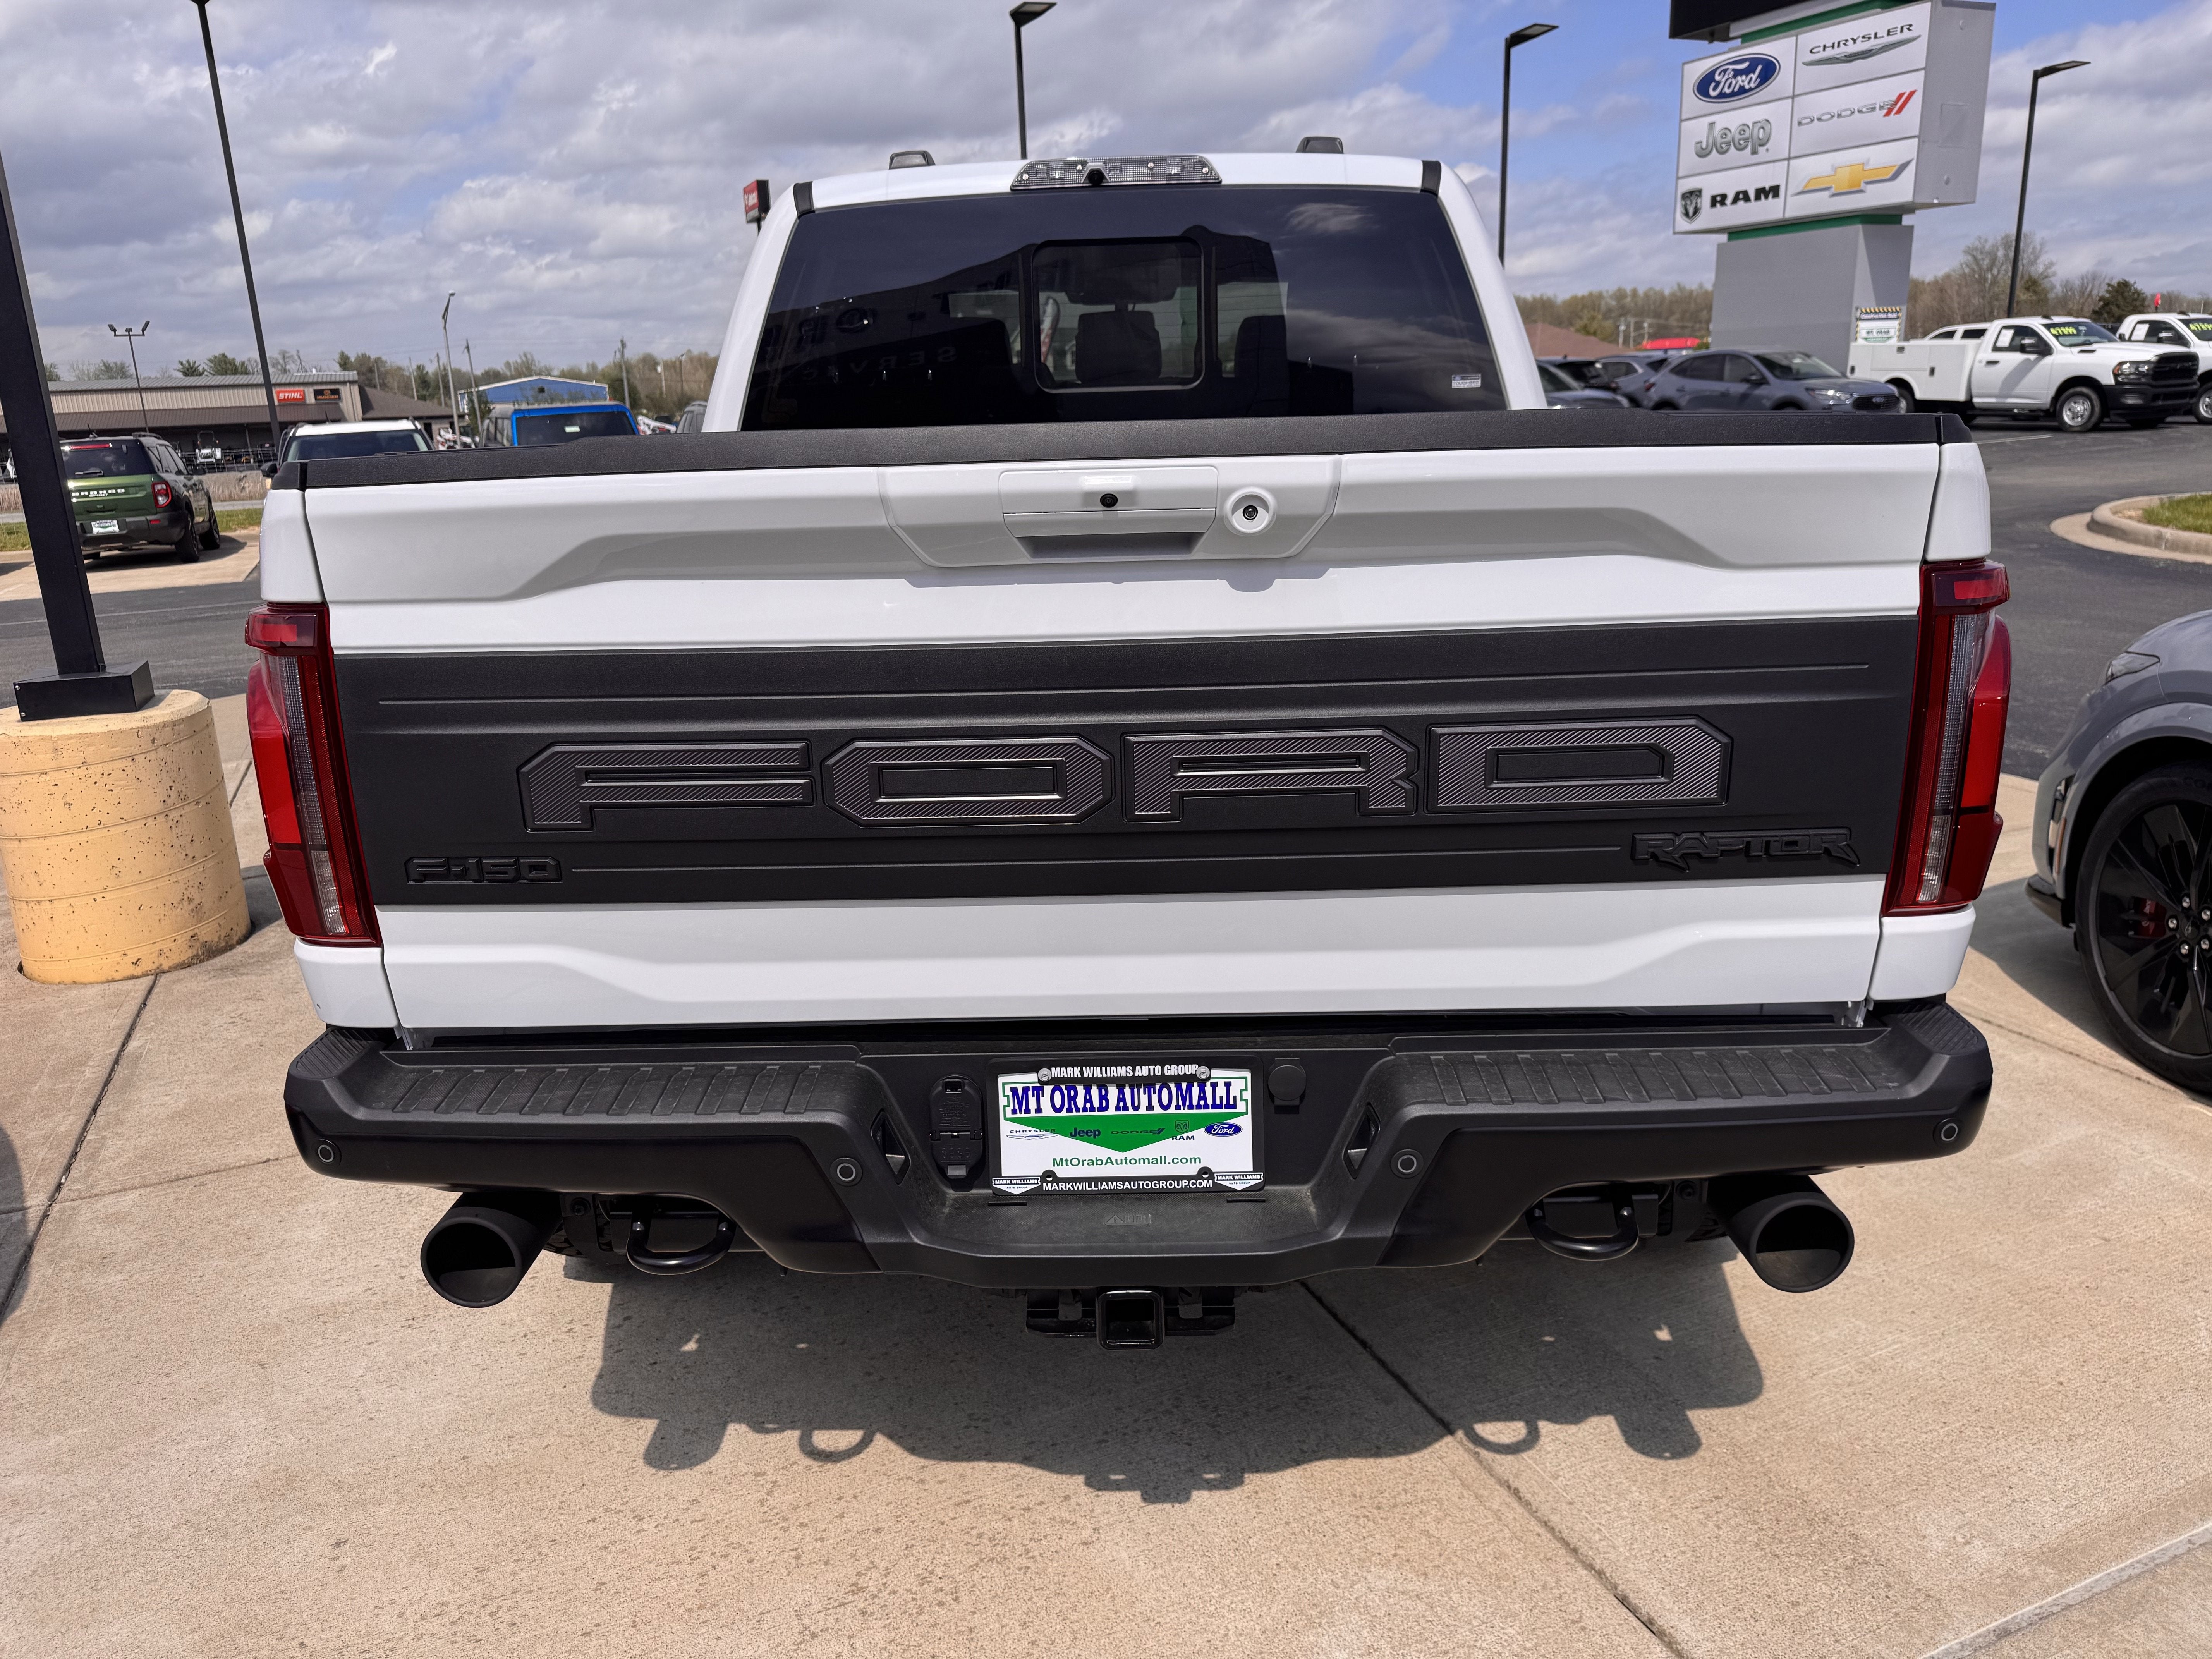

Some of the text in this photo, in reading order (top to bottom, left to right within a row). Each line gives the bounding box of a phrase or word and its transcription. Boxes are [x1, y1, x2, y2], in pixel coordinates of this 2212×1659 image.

[1809, 23, 1914, 54] CHRYSLER
[1708, 59, 1760, 98] Ford
[1797, 99, 1897, 127] DODGE
[1694, 118, 1772, 158] Jeep
[1710, 184, 1780, 209] RAM
[521, 718, 1730, 831] FORD
[1630, 827, 1860, 872] RAPTOR
[404, 856, 562, 884] F-150
[1051, 1064, 1199, 1078] MARK WILLIAMS AUTO GROUP
[1010, 1081, 1237, 1115] MT ORAB AUTOMALL
[1070, 1127, 1101, 1139] Jeep
[1211, 1124, 1234, 1135] Ford
[1052, 1155, 1202, 1167] MtOrabAutomall.com
[1043, 1179, 1213, 1192] MARKWILLIAMSAUTOGROUP.COM
